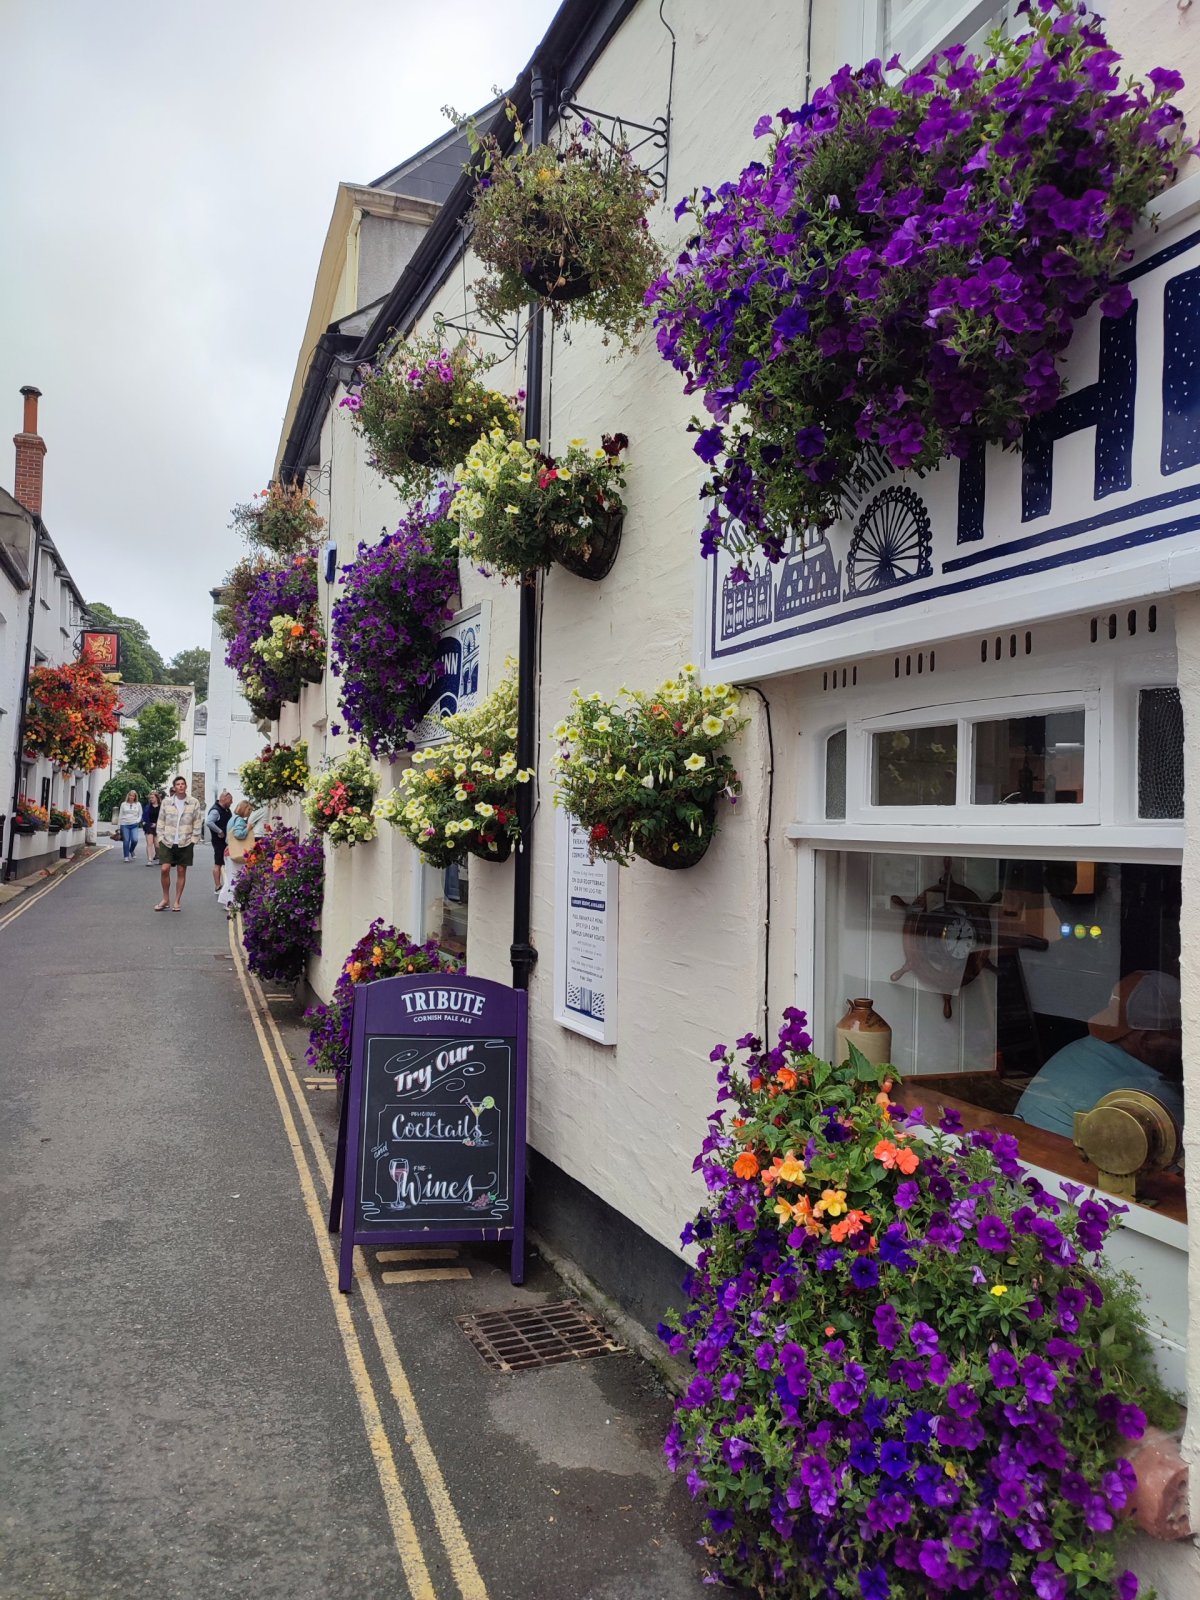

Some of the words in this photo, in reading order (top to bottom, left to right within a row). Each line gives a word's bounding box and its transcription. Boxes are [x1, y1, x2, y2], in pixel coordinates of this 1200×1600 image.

[442, 652, 459, 675] NN
[401, 990, 486, 1016] TRIBUTE
[414, 1014, 442, 1023] CORNISH
[444, 1014, 459, 1022] PALE
[460, 1016, 472, 1024] ALE
[394, 1065, 432, 1092] Try
[436, 1045, 474, 1071] Our
[392, 1114, 490, 1139] Cocktails
[401, 1172, 492, 1205] Wines
